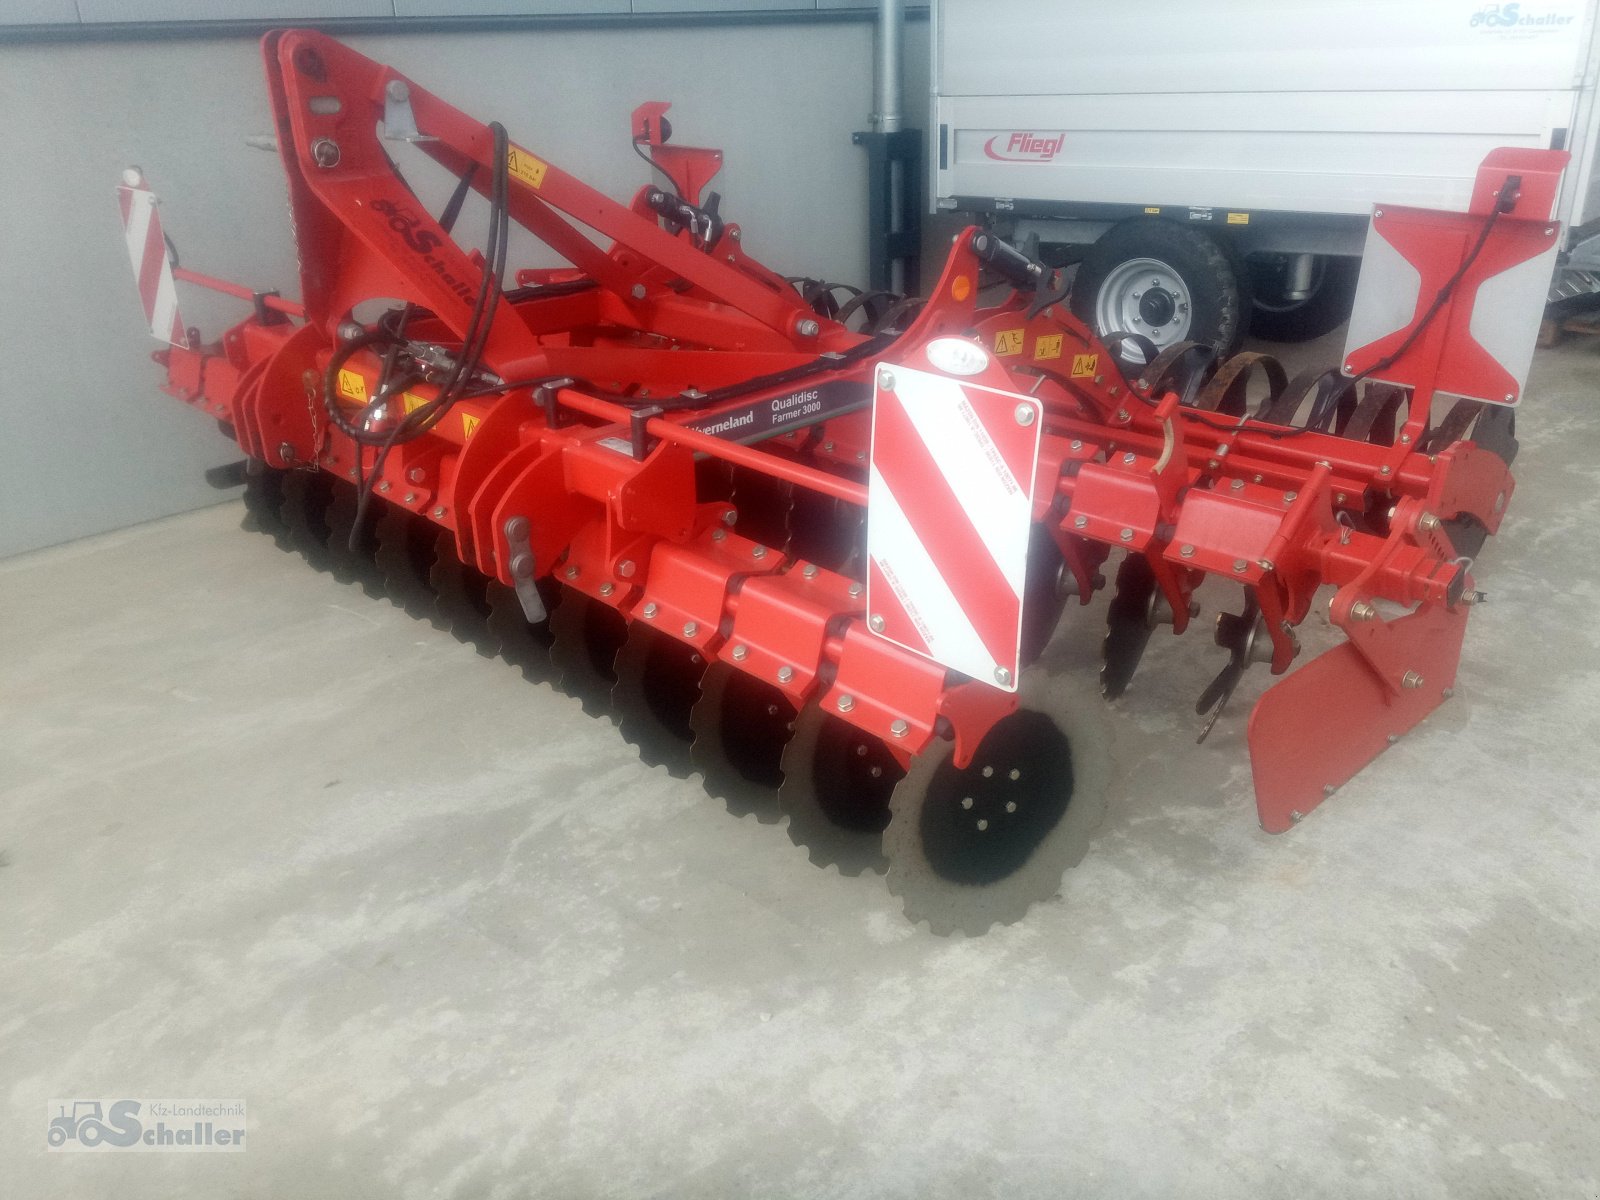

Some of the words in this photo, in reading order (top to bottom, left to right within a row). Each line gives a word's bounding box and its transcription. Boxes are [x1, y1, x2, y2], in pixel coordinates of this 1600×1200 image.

[1502, 3, 1576, 27] Schaller
[1006, 132, 1066, 158] Fliegl
[771, 390, 818, 412] Qualidisc
[772, 408, 801, 424] Farmer
[802, 401, 821, 415] 3000
